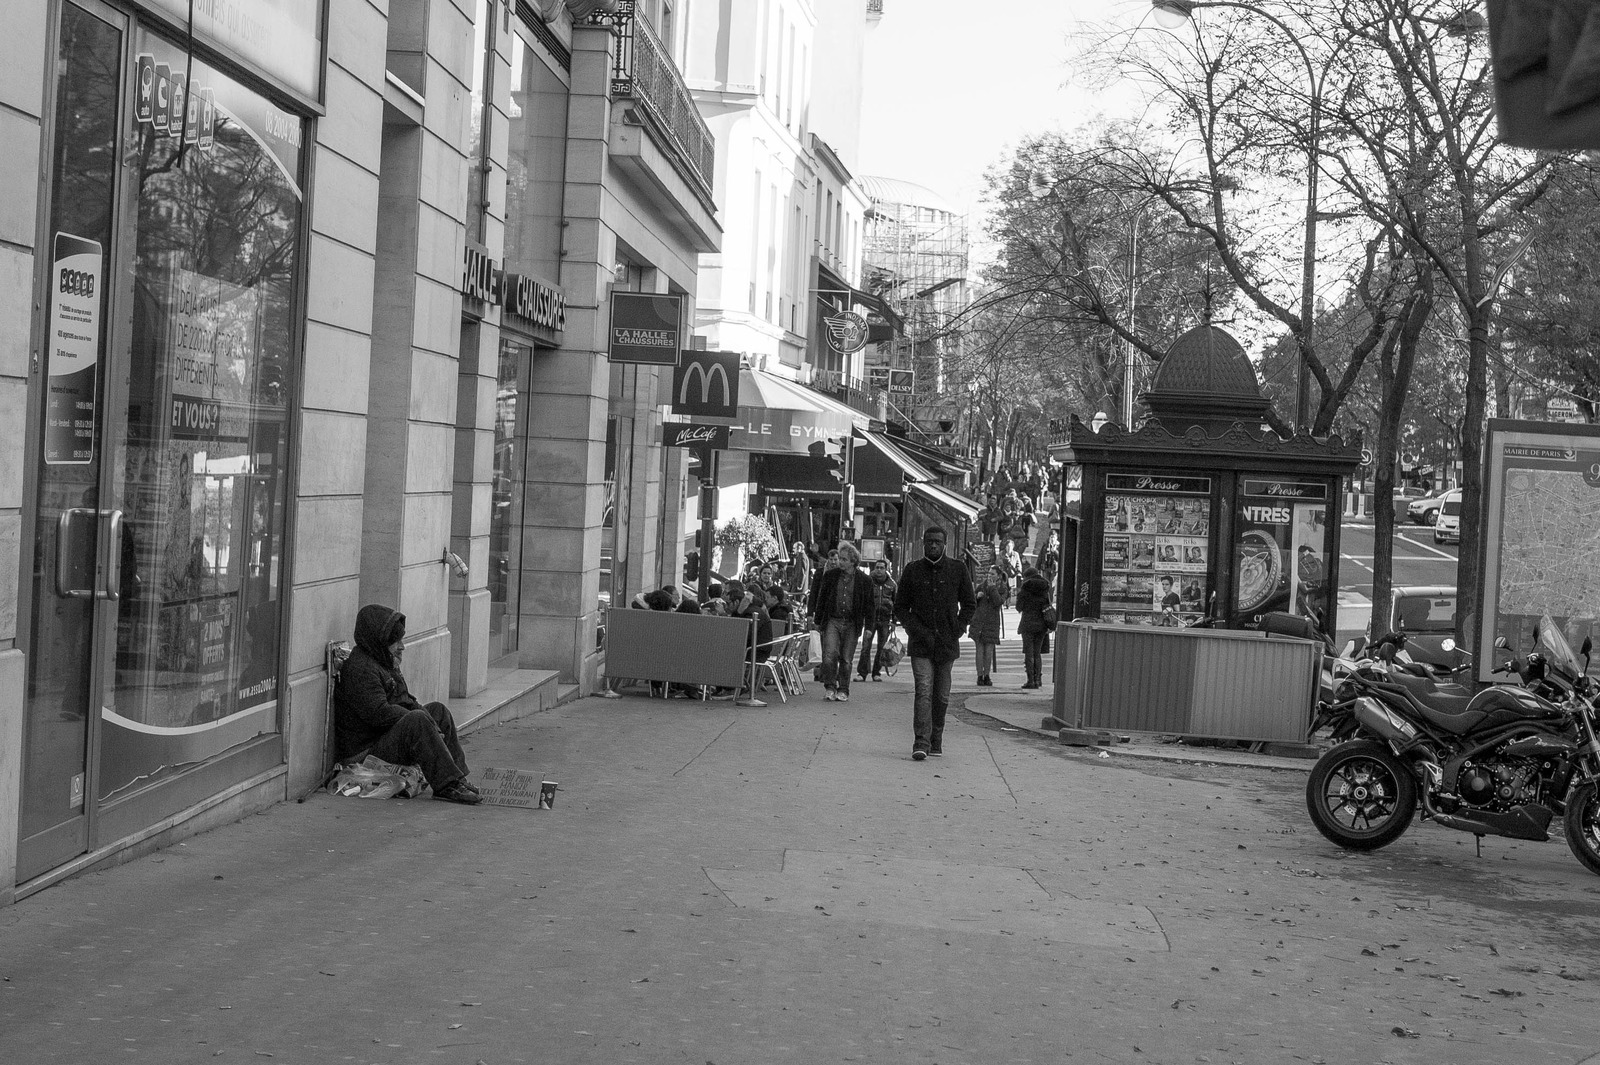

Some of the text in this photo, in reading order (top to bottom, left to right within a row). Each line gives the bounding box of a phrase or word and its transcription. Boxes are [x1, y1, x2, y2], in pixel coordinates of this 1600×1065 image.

[463, 246, 497, 304] HALLE
[516, 274, 567, 332] CHAUSSURES
[845, 312, 867, 331] INDIANA
[177, 323, 188, 348] DE
[615, 329, 630, 338] LA
[632, 330, 668, 340] HALLE
[618, 336, 674, 347] CHAUSSURES
[890, 384, 912, 392] DELSEY
[172, 400, 184, 427] ET
[747, 422, 772, 435] LE
[1135, 476, 1181, 490] Presse
[1268, 483, 1304, 496] Presse
[203, 619, 224, 642] 2 MOIS
[202, 643, 225, 666] OFFERTS
[239, 675, 277, 700] www.assu2000.fr
